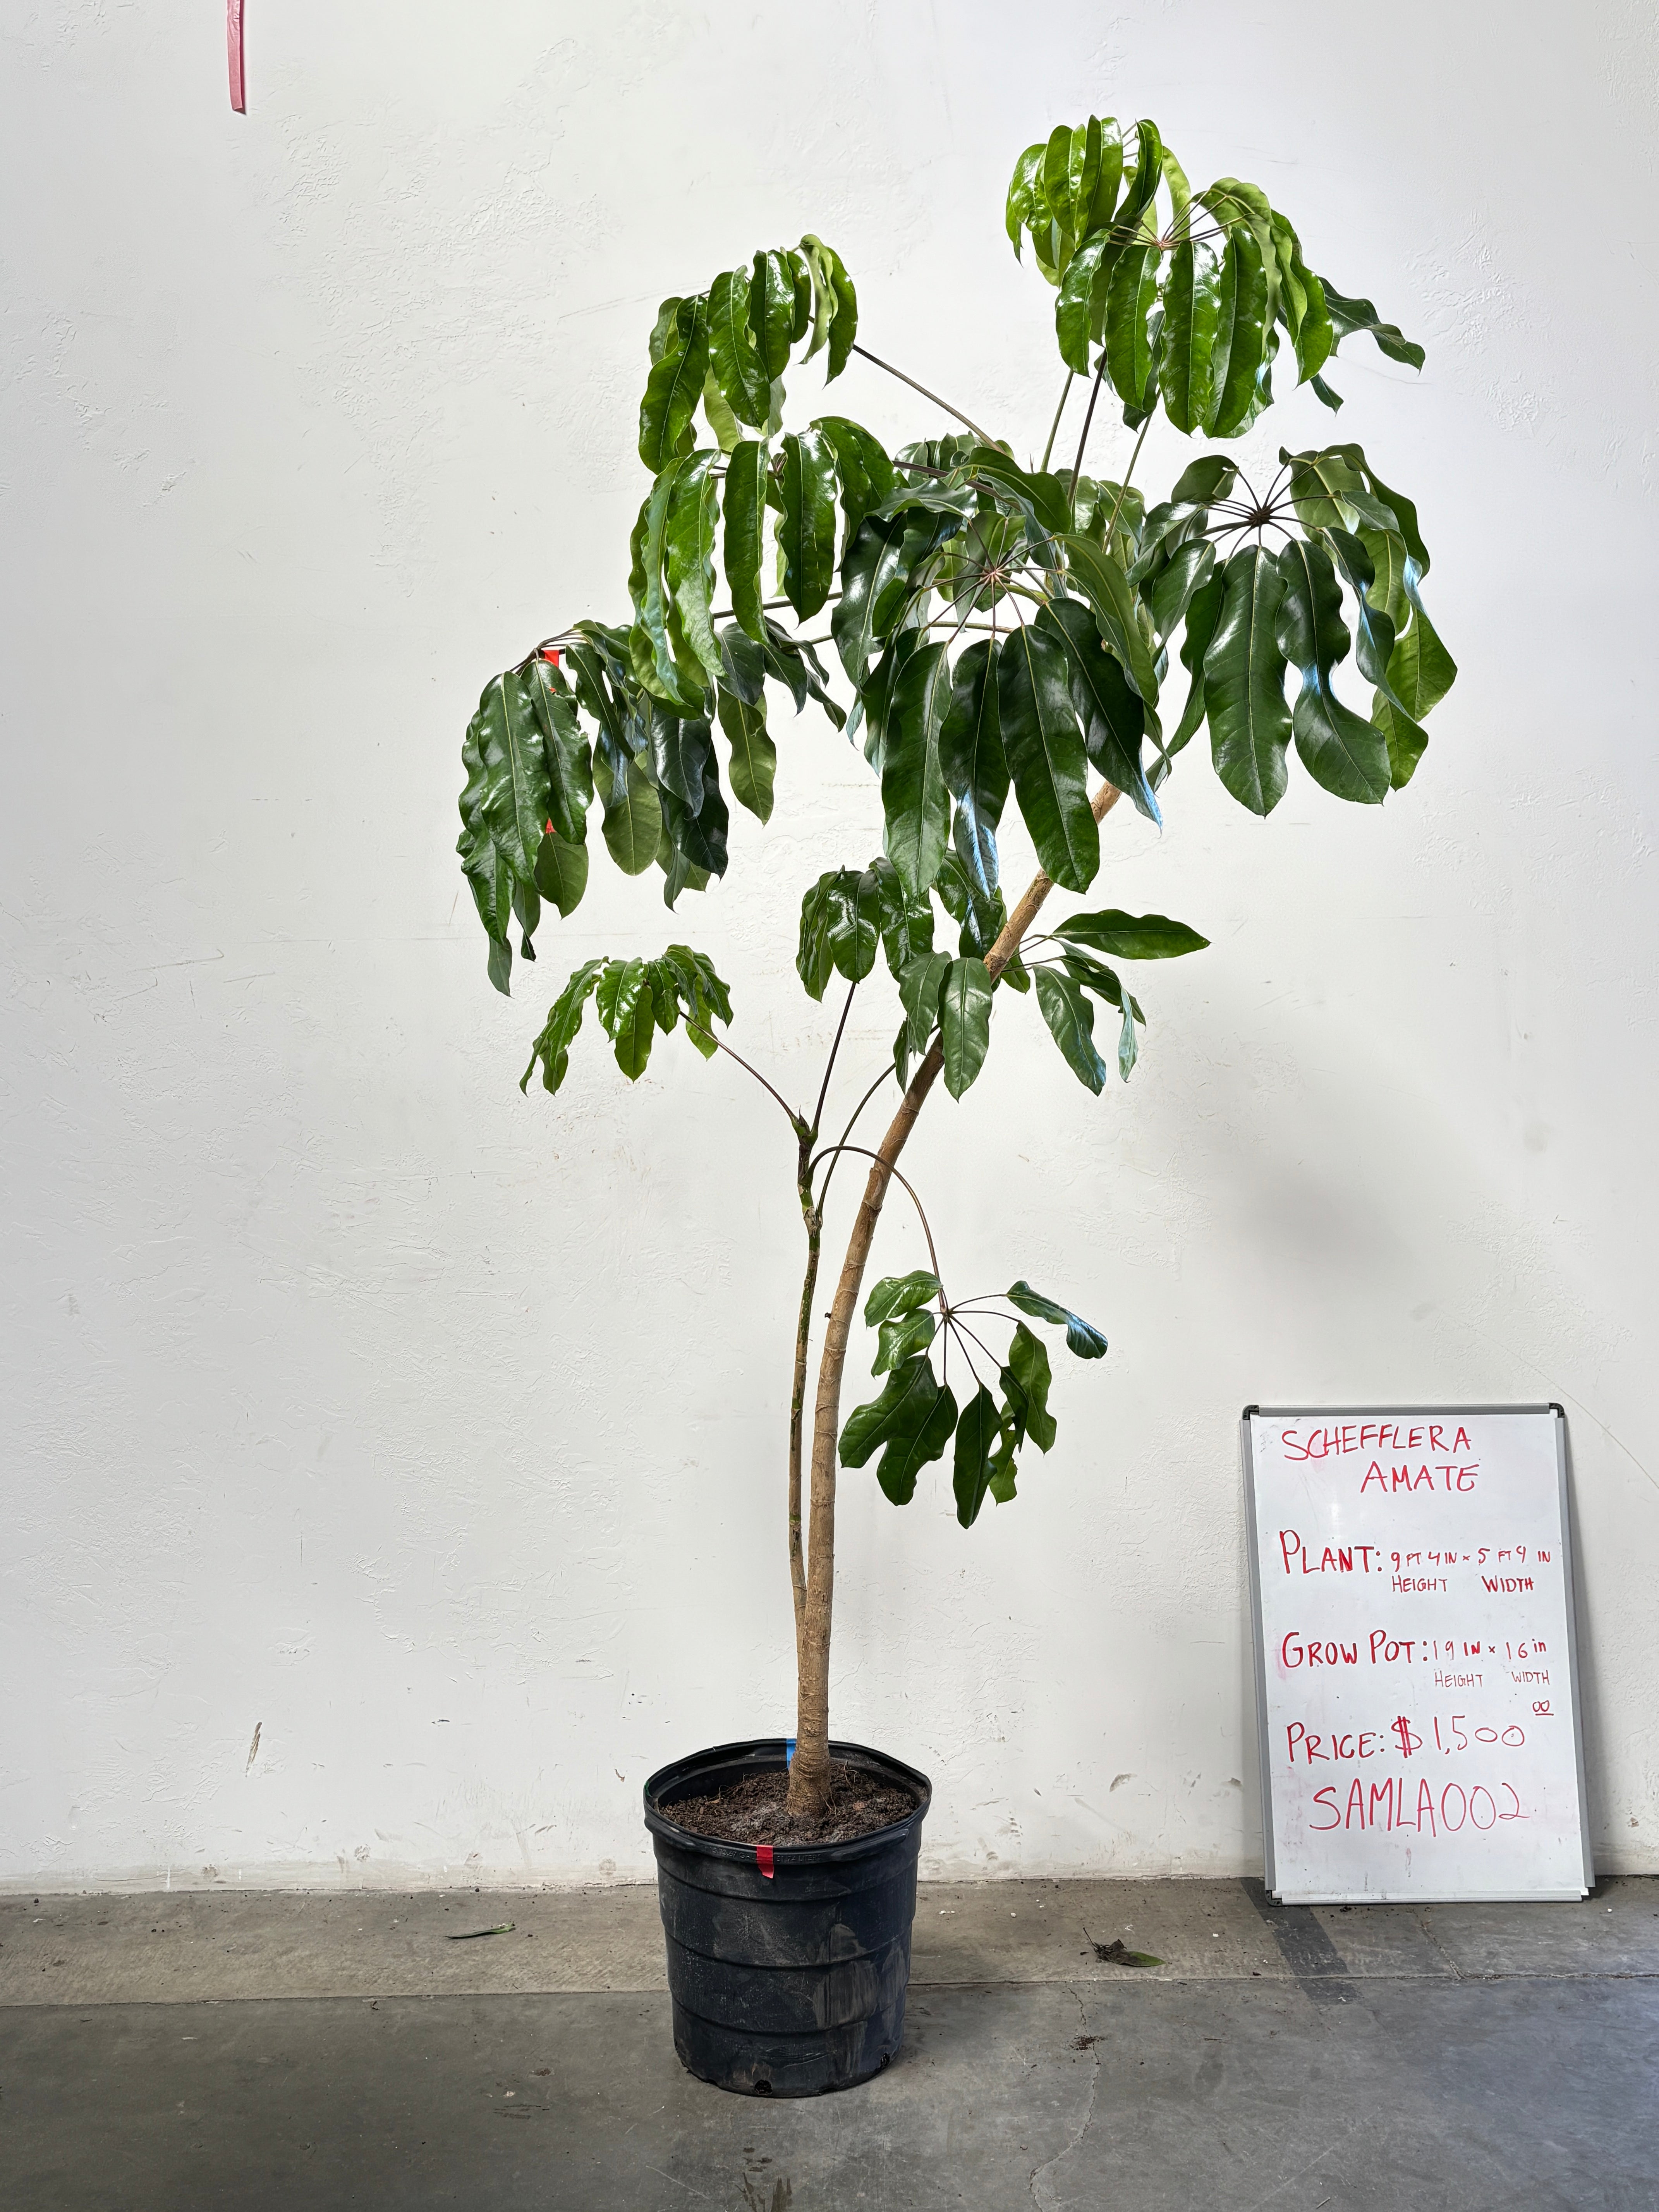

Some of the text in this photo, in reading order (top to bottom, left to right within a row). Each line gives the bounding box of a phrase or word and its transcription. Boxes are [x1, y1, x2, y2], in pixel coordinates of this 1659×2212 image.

[1281, 1424, 1472, 1462] SCHEFFLERA
[1360, 1461, 1479, 1493] AMATE
[1279, 1529, 1382, 1574] PLANT:
[1390, 1551, 1401, 1572] 9
[1406, 1552, 1421, 1566] FT
[1477, 1547, 1490, 1566] 5
[1498, 1550, 1511, 1561] FT
[1537, 1551, 1551, 1563] IN
[1392, 1575, 1534, 1593] HEIGHT WIDTH
[1281, 1632, 1357, 1669] GROW
[1369, 1629, 1428, 1665] POT:
[1463, 1640, 1481, 1657] IN
[1506, 1642, 1528, 1661] 16
[1434, 1670, 1550, 1688] HEIGHT WIDTH
[1286, 1721, 1385, 1765] PRICE:
[1309, 1778, 1530, 1838] SAMLA002
